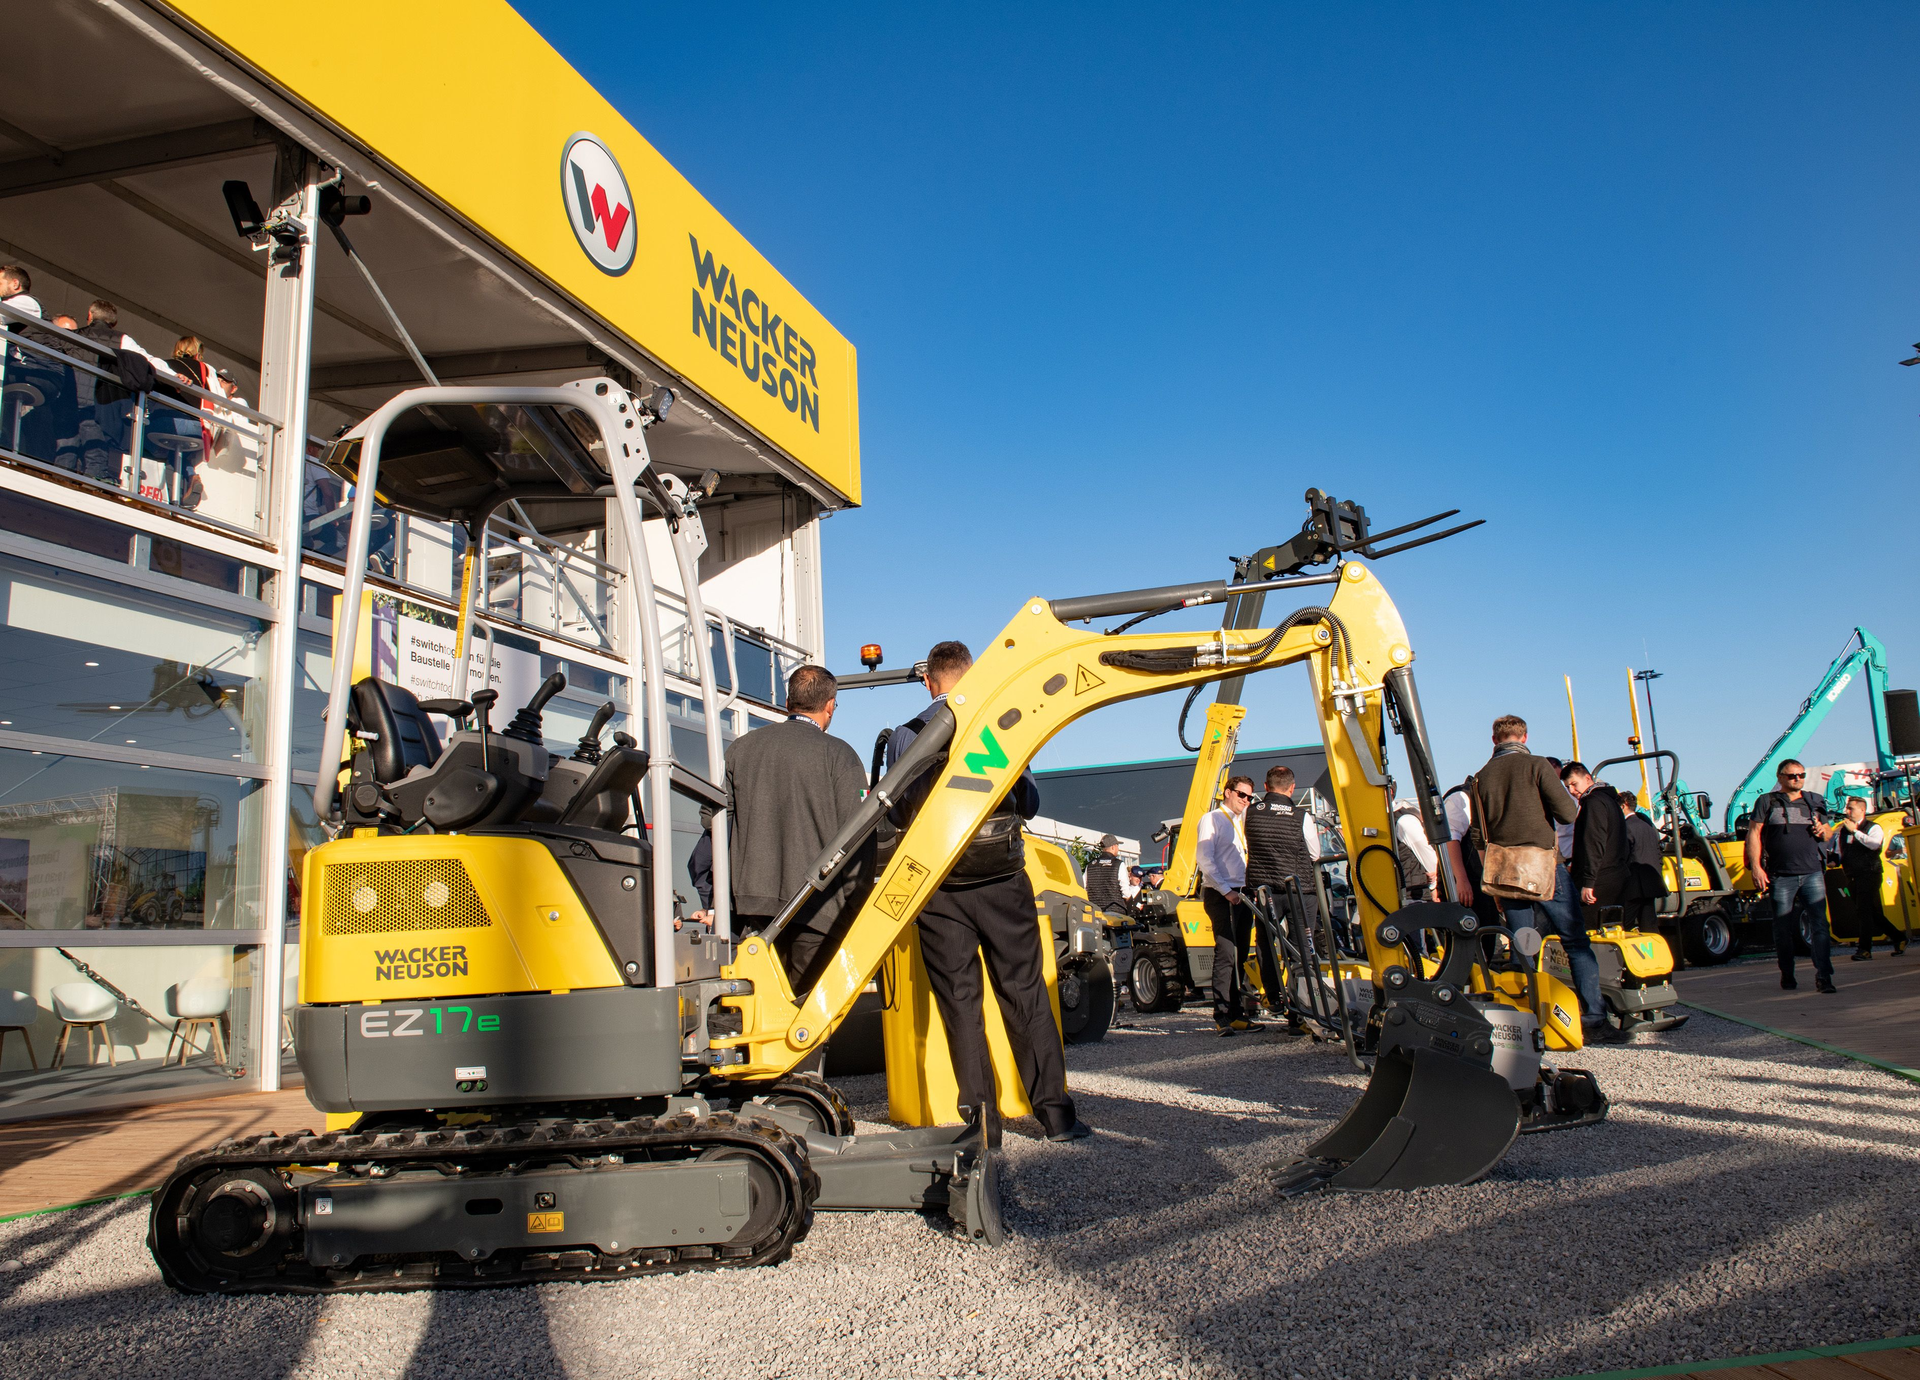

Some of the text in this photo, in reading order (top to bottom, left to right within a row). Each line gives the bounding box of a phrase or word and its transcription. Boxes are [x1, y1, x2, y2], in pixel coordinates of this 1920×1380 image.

[688, 231, 819, 390] WACKER
[692, 287, 819, 434] NEUSON
[411, 651, 450, 671] Baustelle
[1826, 673, 1851, 702] KOBELCO
[374, 946, 468, 965] WACKER
[1550, 948, 1568, 958] WAC
[1550, 955, 1569, 967] NEU
[376, 961, 468, 981] NEUSON
[361, 1006, 500, 1038] EZ17e
[1493, 1024, 1522, 1034] WACKER
[1435, 1037, 1460, 1048] WACKER
[1491, 1032, 1522, 1042] NEUSON
[1434, 1042, 1460, 1053] NEUSON
